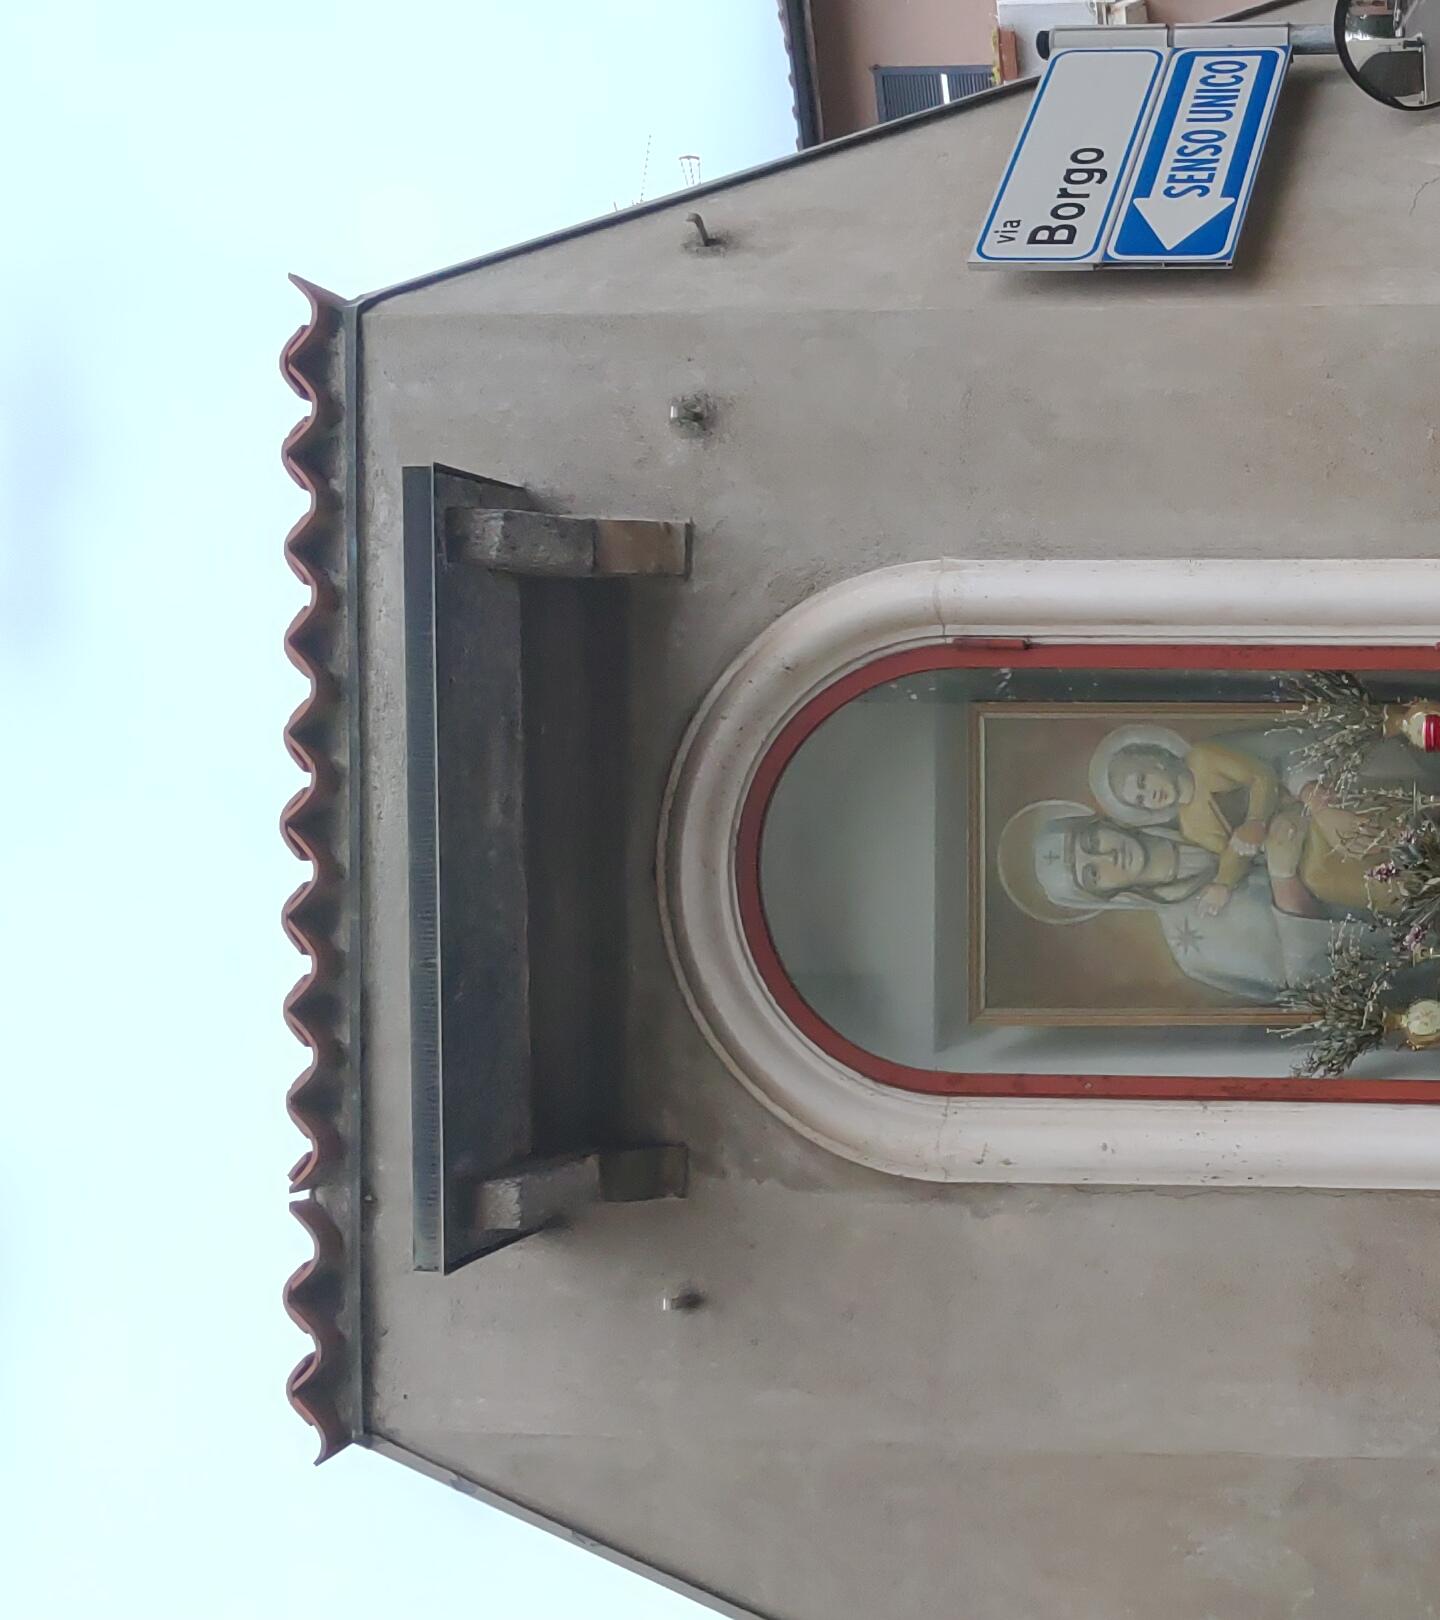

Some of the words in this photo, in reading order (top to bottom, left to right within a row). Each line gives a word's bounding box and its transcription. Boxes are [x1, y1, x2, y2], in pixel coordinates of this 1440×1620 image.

[1186, 60, 1248, 122] UNICO
[1027, 147, 1108, 245] Borgo
[1163, 129, 1228, 198] SENSO
[994, 219, 1021, 244] via
